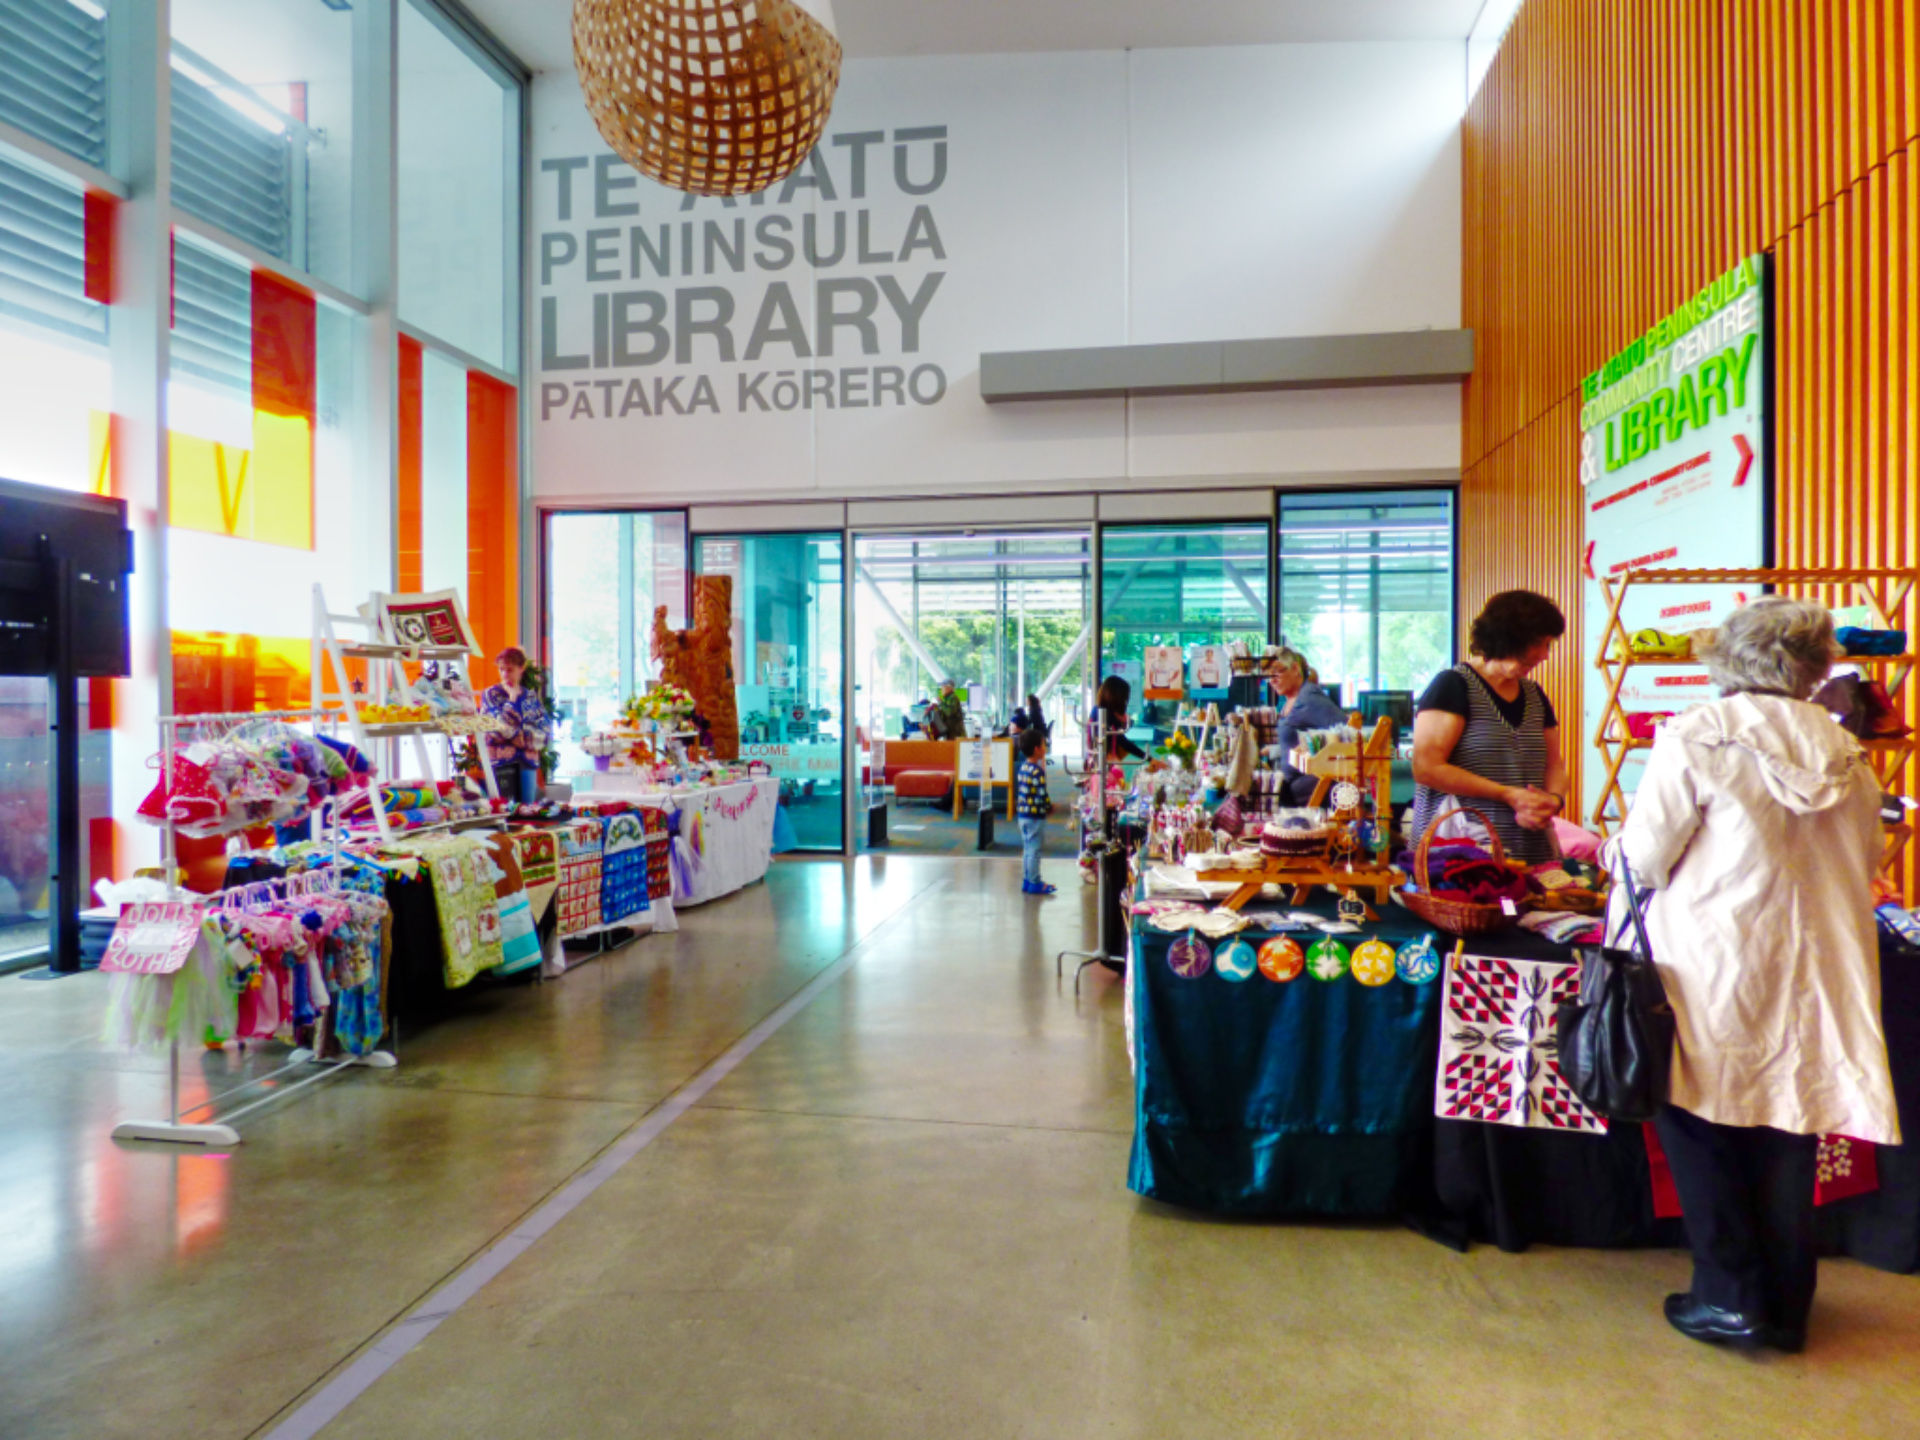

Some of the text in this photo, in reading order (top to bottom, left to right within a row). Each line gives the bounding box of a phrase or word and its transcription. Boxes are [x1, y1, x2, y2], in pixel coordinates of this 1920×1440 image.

[541, 125, 947, 221] TE ATŪ
[541, 205, 947, 286] PENINSULA
[541, 271, 947, 371] LIBRARY
[1580, 370, 1599, 403] TE
[1646, 257, 1758, 357] PENINSULA
[1580, 292, 1757, 432] COMMUNITY CENTRE
[541, 374, 720, 421] PĀTAKA
[1579, 432, 1599, 486] &
[1604, 333, 1758, 473] LIBRARY
[739, 744, 789, 757] LCOME
